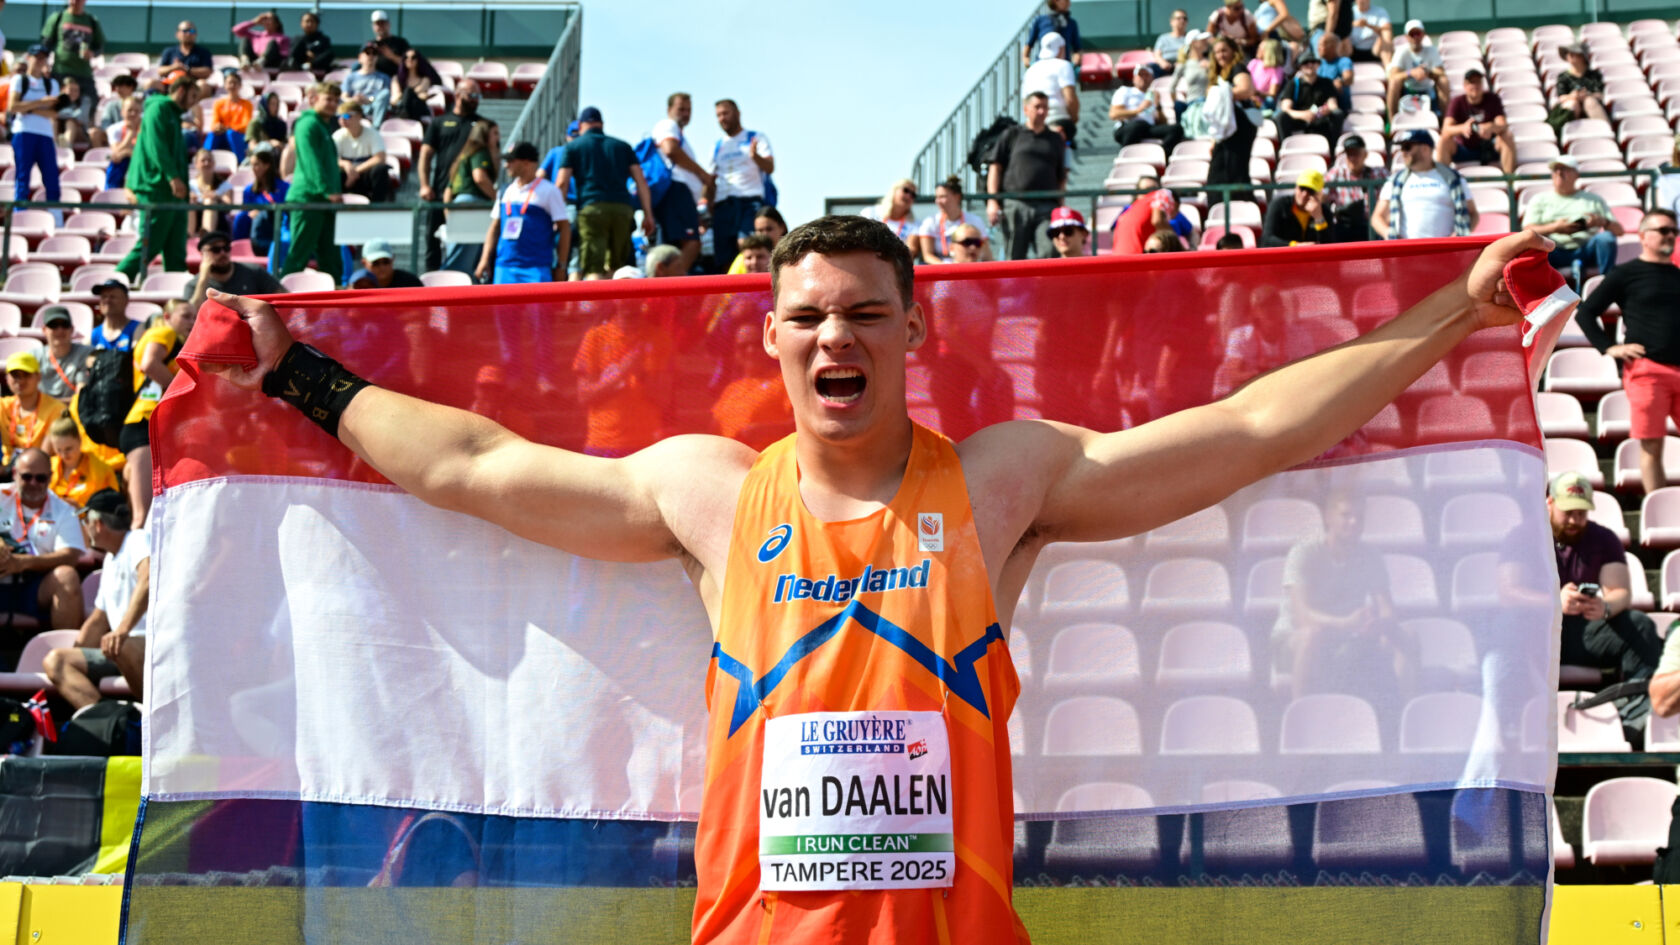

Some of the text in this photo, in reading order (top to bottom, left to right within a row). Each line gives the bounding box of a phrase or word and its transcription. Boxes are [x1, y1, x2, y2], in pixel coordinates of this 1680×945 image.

[773, 559, 931, 603] nederland
[801, 719, 819, 742] LE
[804, 744, 901, 754] SWITZERLAND
[763, 774, 947, 818] van DAALEN
[796, 837, 801, 852] I
[805, 837, 844, 851] RUN
[771, 860, 947, 882] TAMPERE 2025
